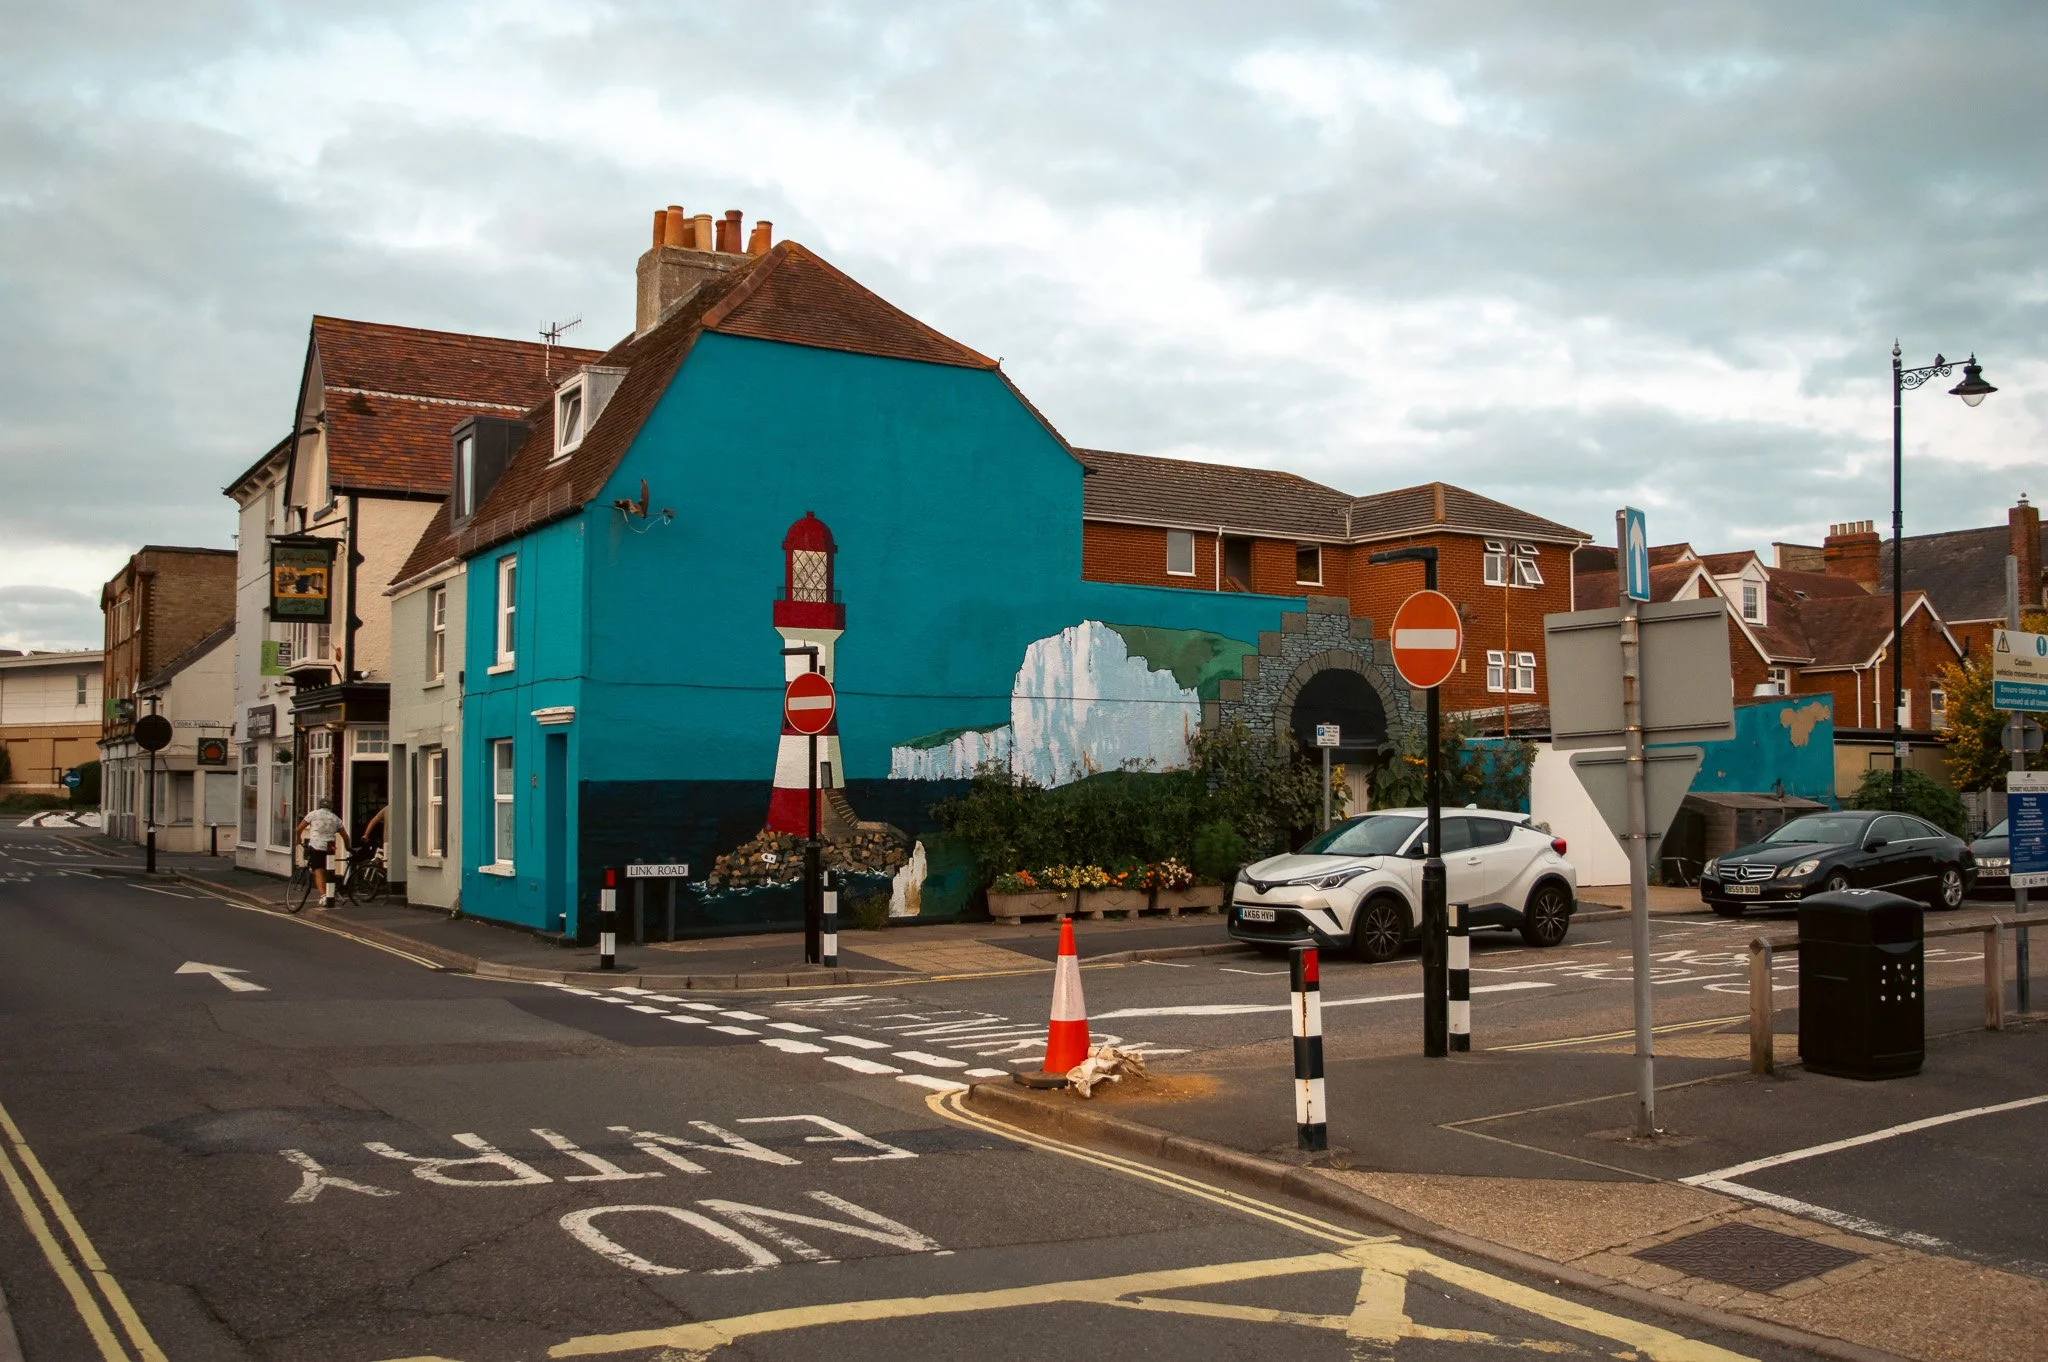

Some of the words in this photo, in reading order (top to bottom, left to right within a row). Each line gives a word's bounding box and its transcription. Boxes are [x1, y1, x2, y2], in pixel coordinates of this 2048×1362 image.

[2000, 685, 2018, 693] Ensure
[2018, 686, 2037, 695] children
[1996, 698, 2023, 706] supervised
[630, 866, 653, 876] LINK
[657, 865, 686, 875] ROAD
[1244, 910, 1260, 919] AK66
[1261, 911, 1274, 920] HVH
[278, 1115, 920, 1204] ENTRY
[559, 1190, 958, 1276] NO
